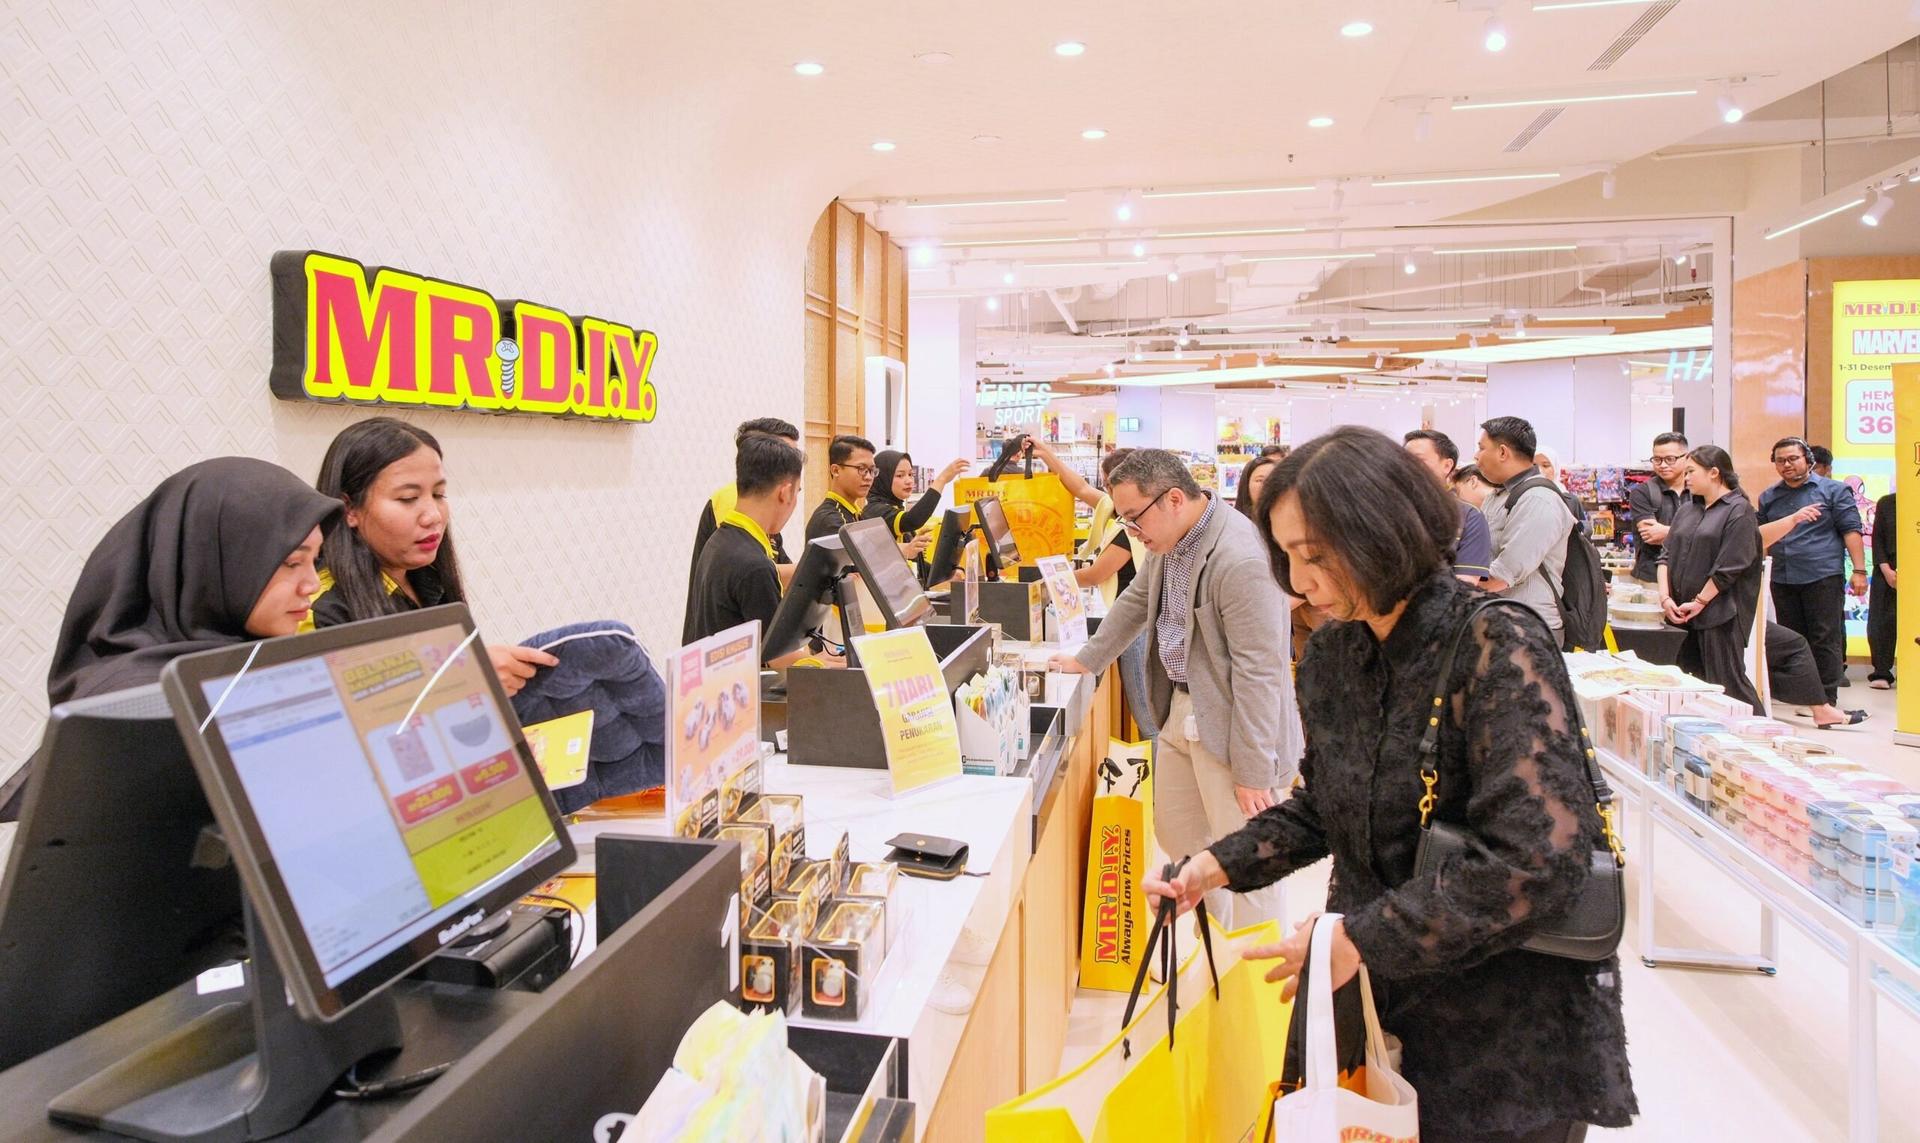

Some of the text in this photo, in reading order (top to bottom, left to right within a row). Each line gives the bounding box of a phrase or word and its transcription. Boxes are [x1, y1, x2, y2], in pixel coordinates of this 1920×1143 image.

[1852, 329, 1920, 354] MARVE
[1839, 363, 1858, 371] 1-31
[994, 405, 1045, 426] SPORT
[1121, 829, 1133, 965] Always Low Prices
